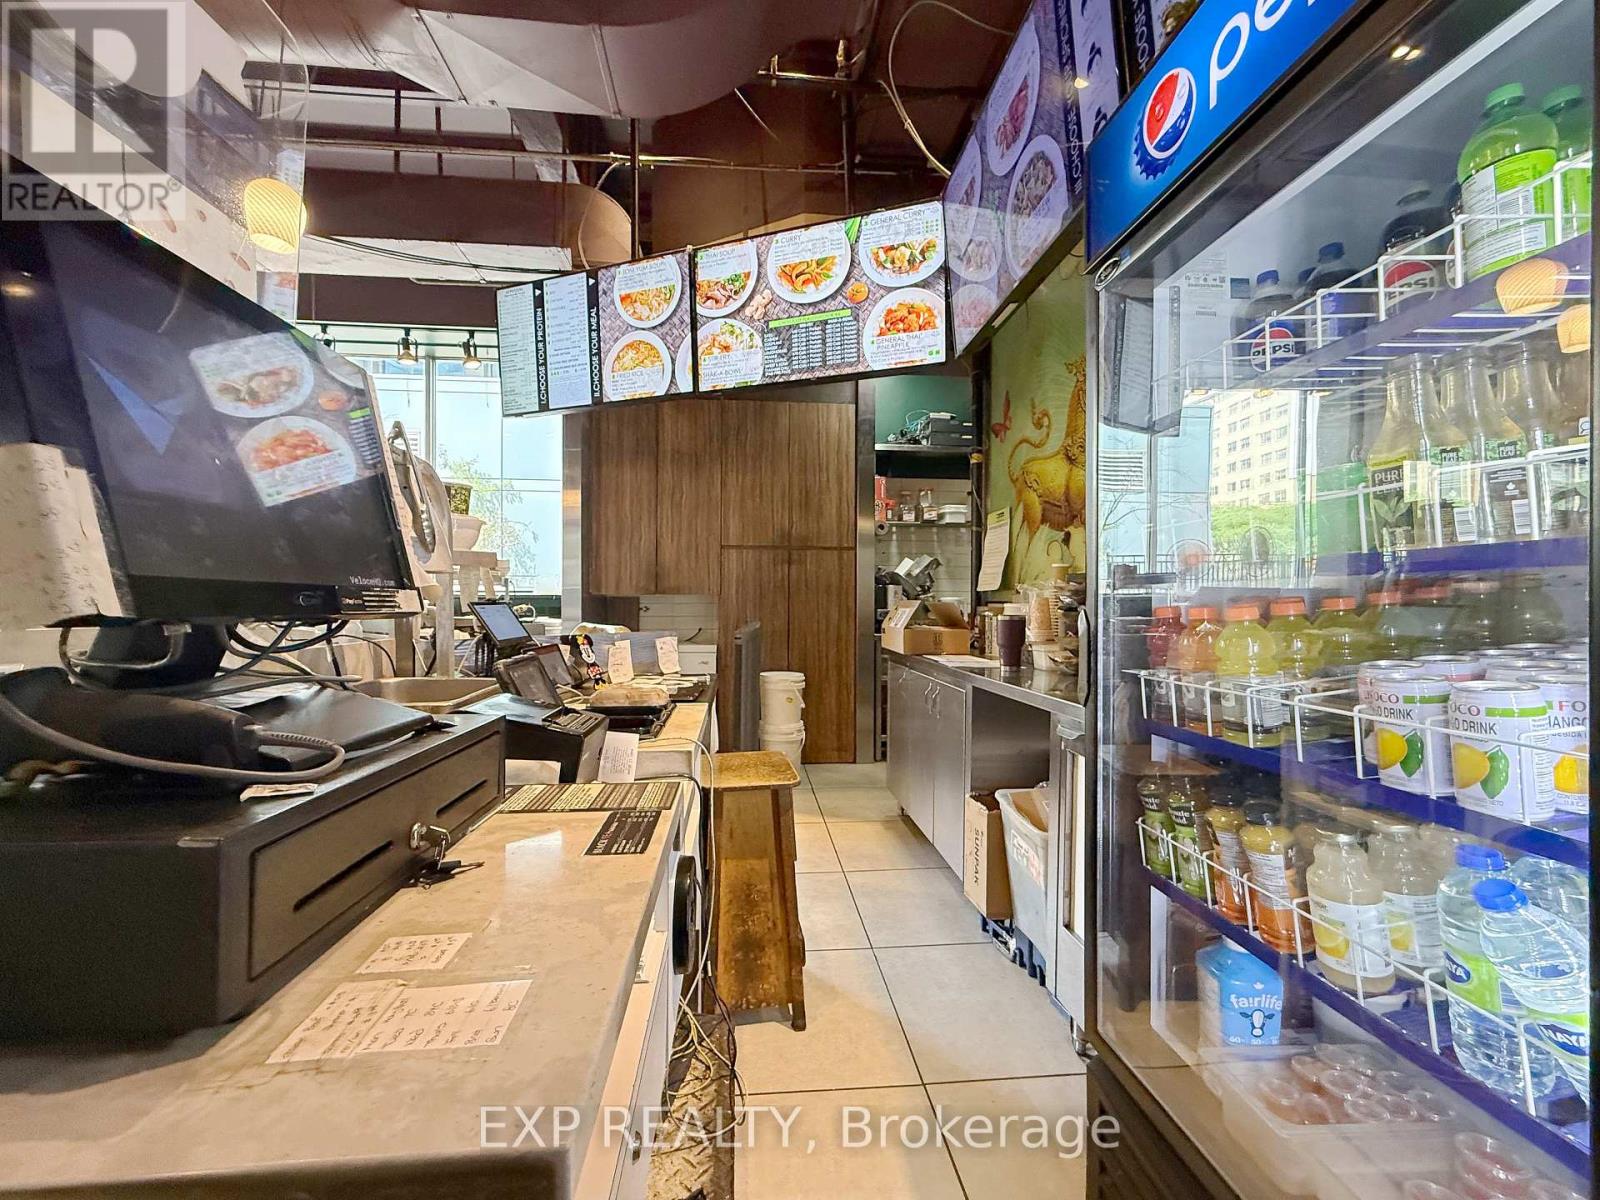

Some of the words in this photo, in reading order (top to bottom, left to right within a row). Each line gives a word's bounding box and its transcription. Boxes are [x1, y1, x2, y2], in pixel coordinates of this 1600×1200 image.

[536, 308, 544, 340] PROTEIN
[1383, 707, 1413, 720] DRINK
[1462, 719, 1497, 735] DRINK
